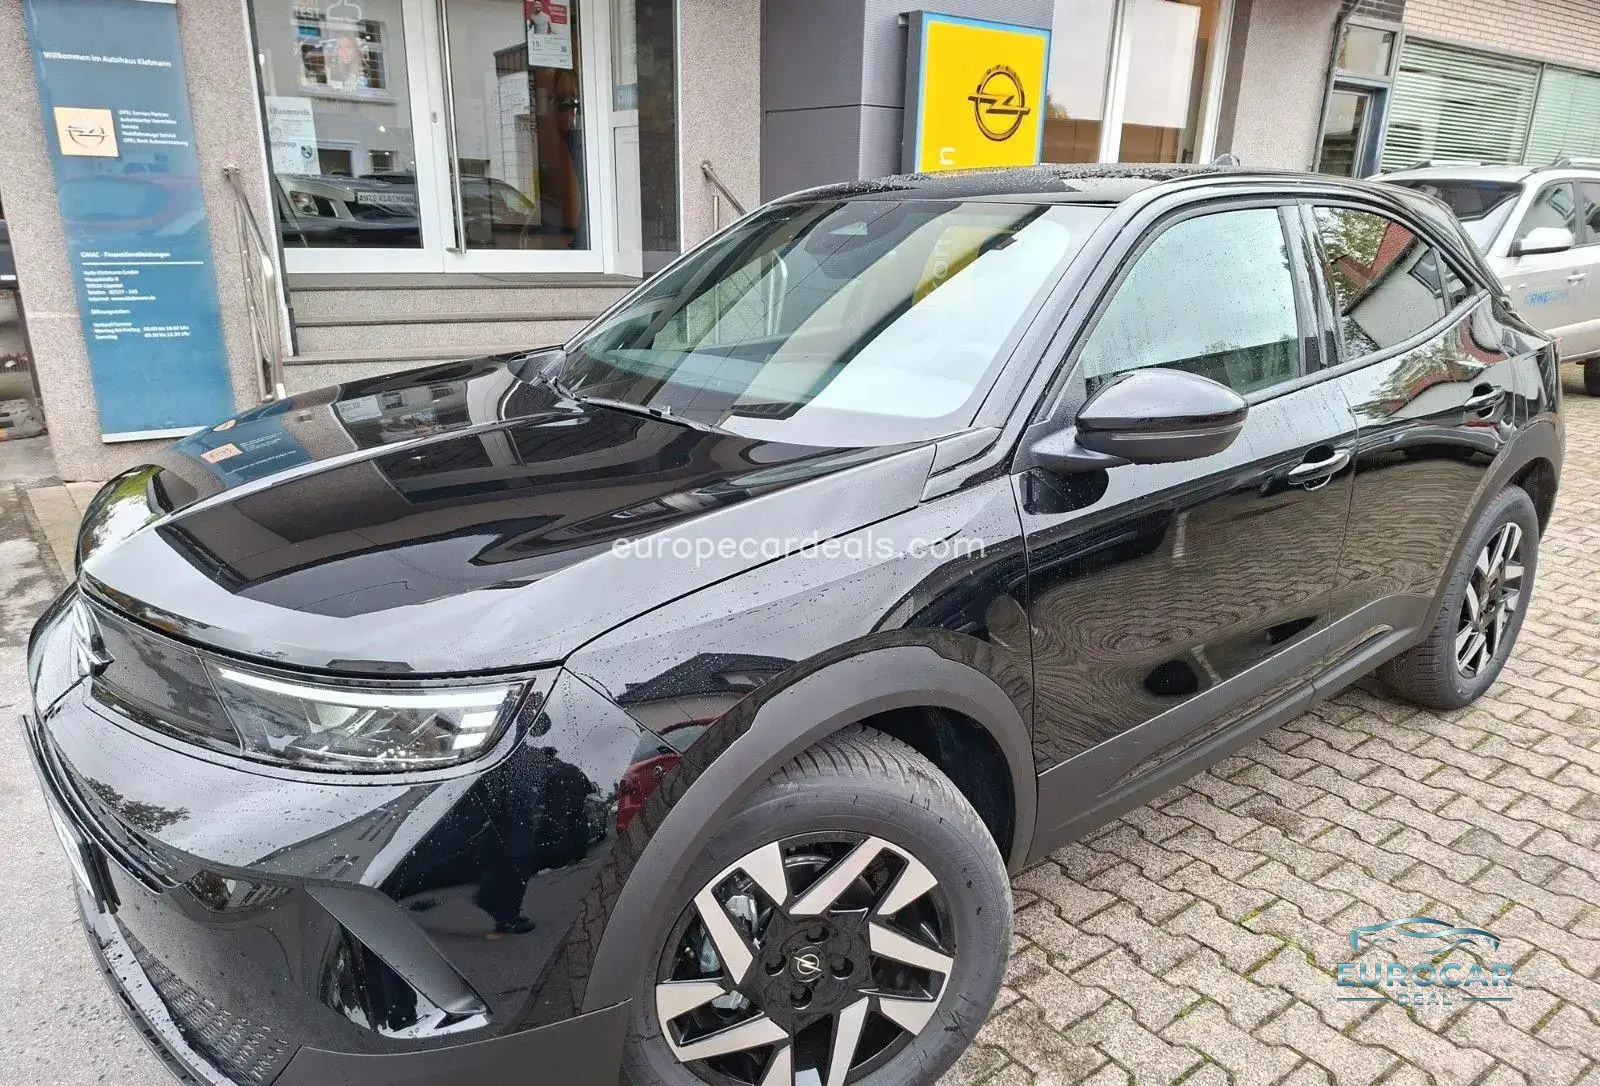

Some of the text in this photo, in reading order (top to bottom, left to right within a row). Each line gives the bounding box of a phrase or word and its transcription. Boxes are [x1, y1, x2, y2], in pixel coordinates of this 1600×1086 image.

[43, 51, 91, 61] Willkommen
[91, 54, 101, 62] im
[102, 55, 137, 65] Autohaus
